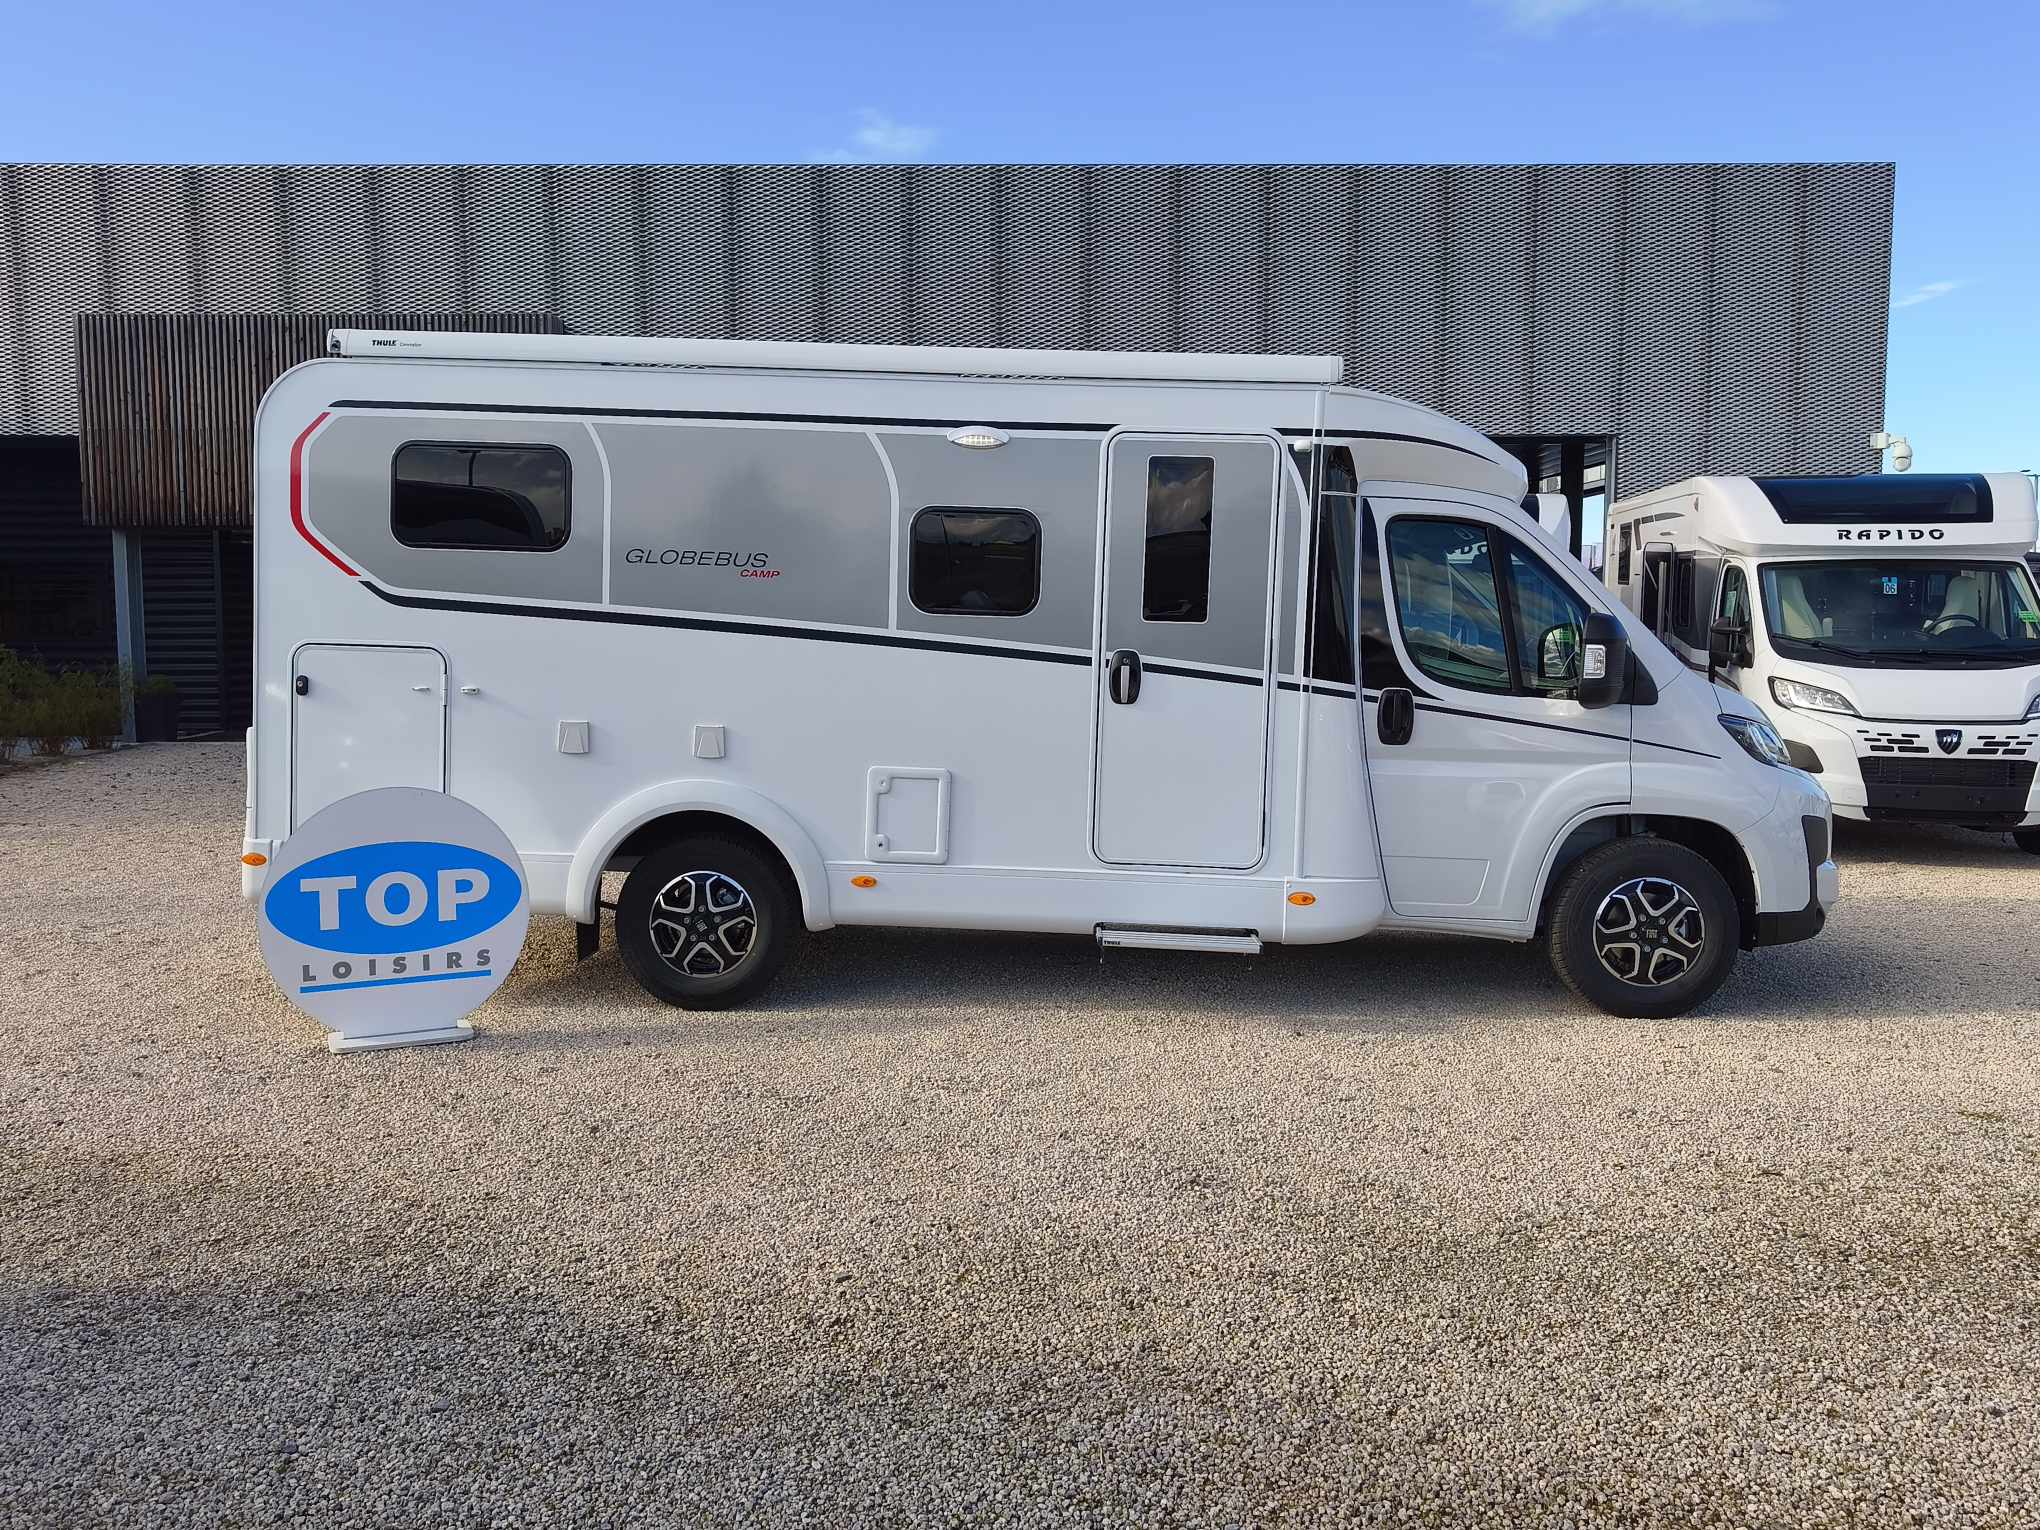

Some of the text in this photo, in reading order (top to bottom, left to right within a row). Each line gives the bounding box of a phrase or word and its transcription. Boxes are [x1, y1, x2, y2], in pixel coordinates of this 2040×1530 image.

[1837, 529, 1944, 540] RAPIDO
[625, 548, 769, 568] GLOBEBUS
[740, 569, 780, 579] CAMP
[300, 868, 490, 931] TOP
[302, 949, 491, 982] LOISIRS
